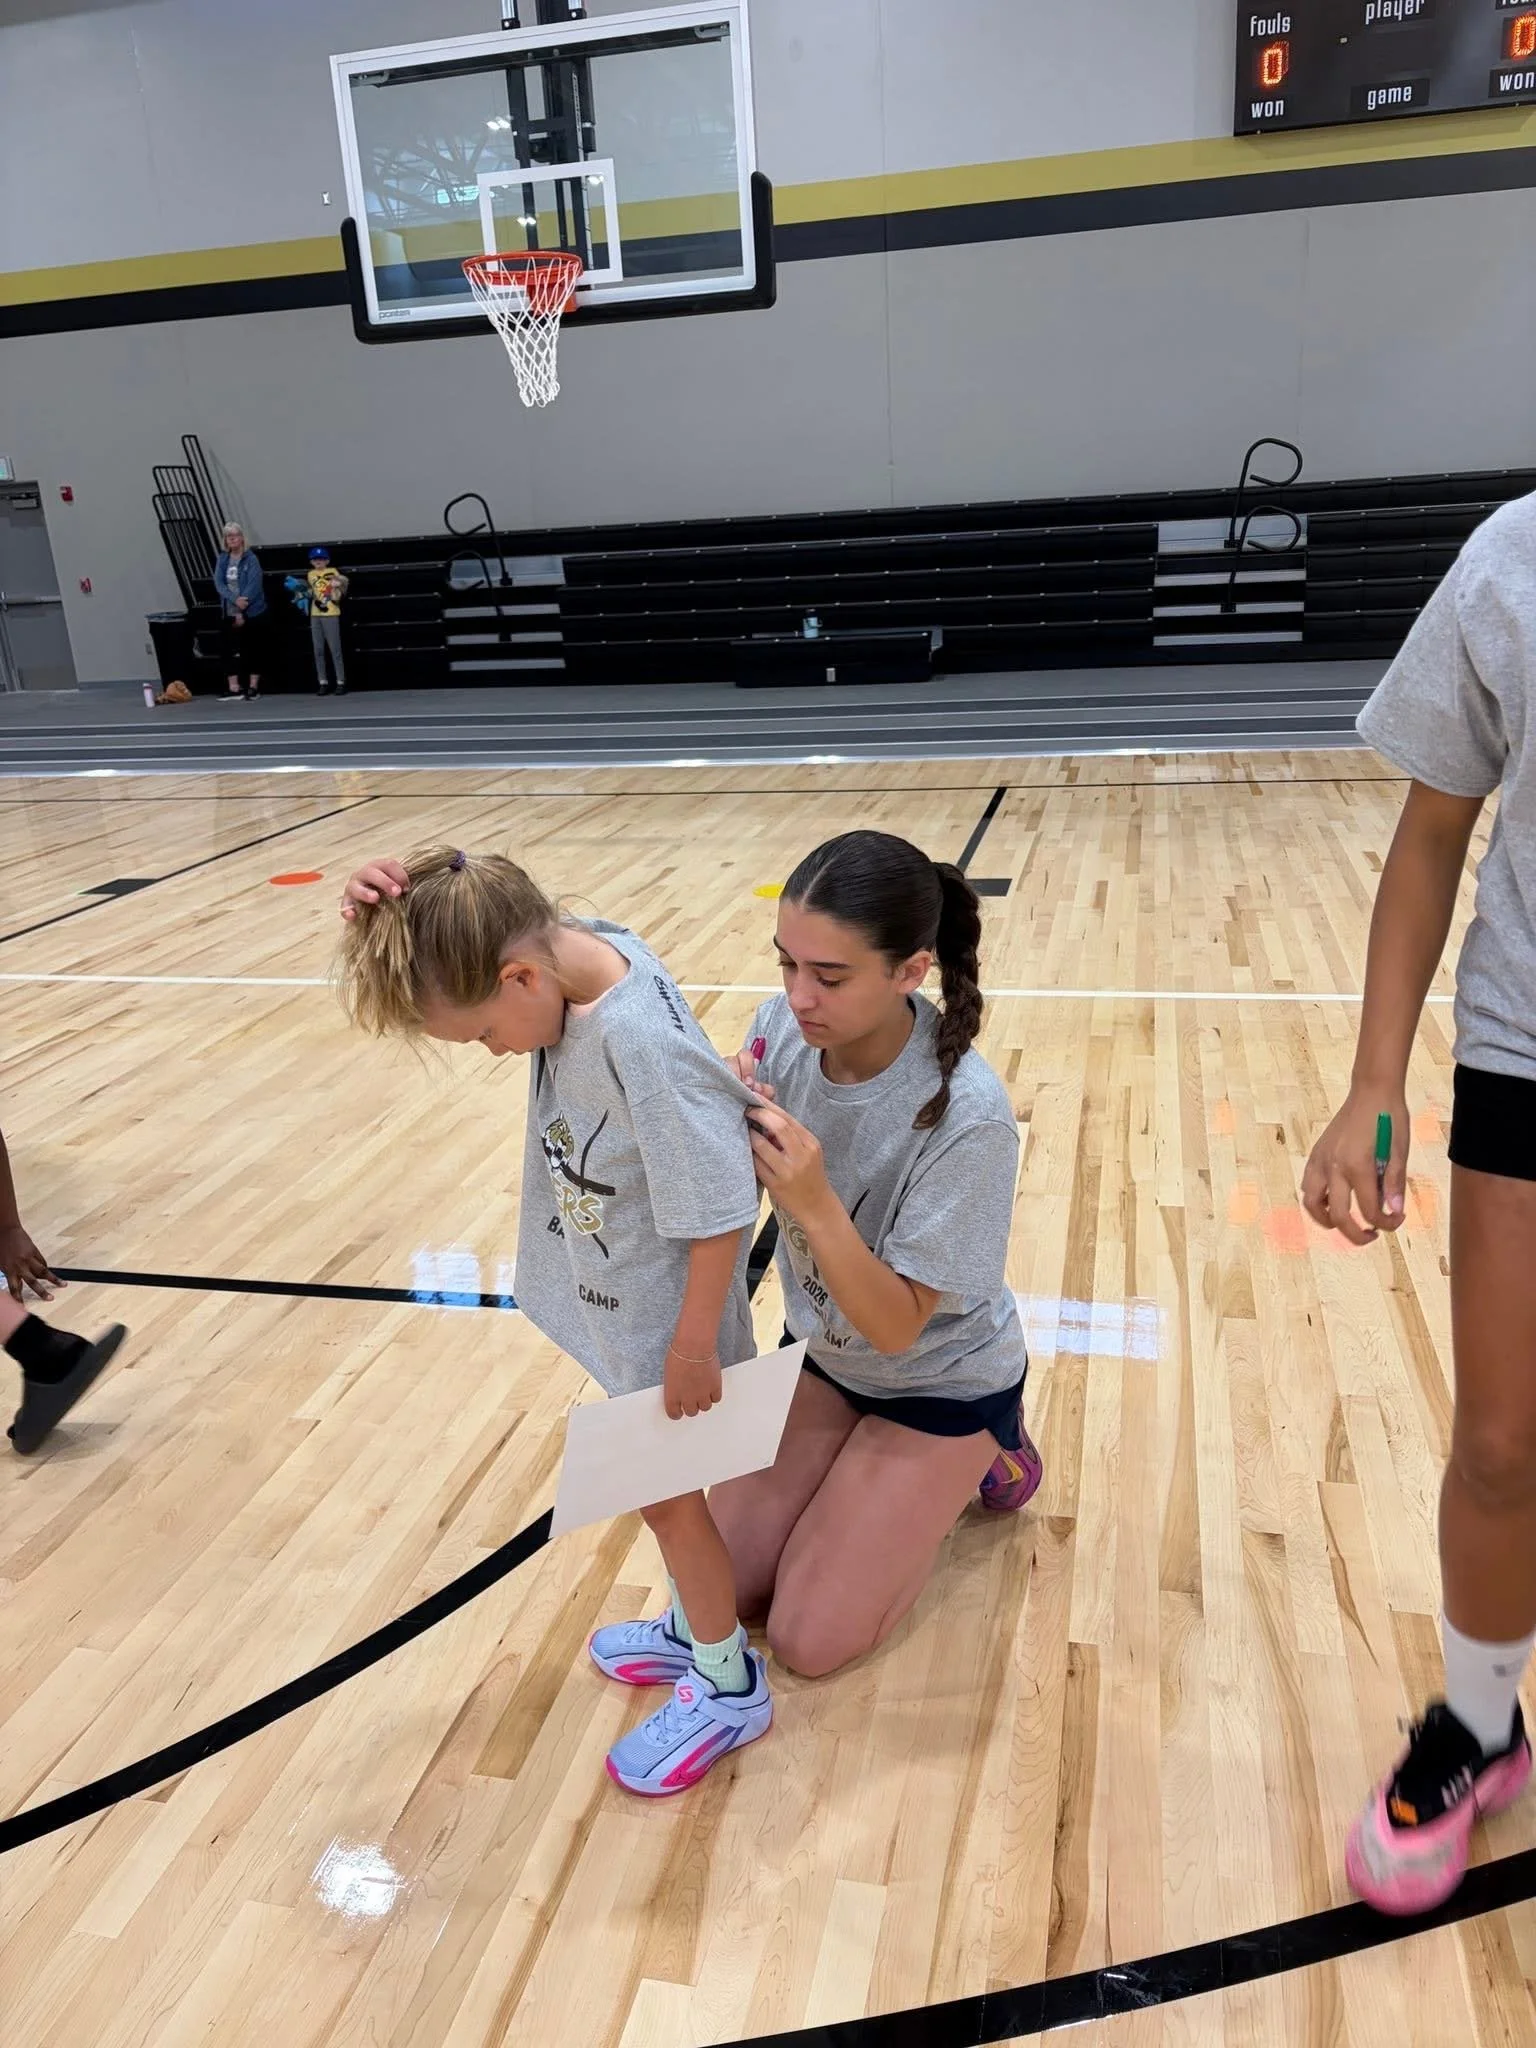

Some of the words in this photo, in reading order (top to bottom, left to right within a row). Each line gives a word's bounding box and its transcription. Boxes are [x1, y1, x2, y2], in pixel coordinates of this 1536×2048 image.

[1250, 13, 1291, 37] fouls
[1365, 0, 1424, 25] player
[1512, 15, 1536, 56] 0
[1263, 48, 1283, 84] 0
[1500, 71, 1536, 91] won
[1251, 100, 1284, 119] won
[1367, 85, 1412, 110] game
[578, 1283, 620, 1312] CAMP
[802, 1275, 829, 1307] 2026
